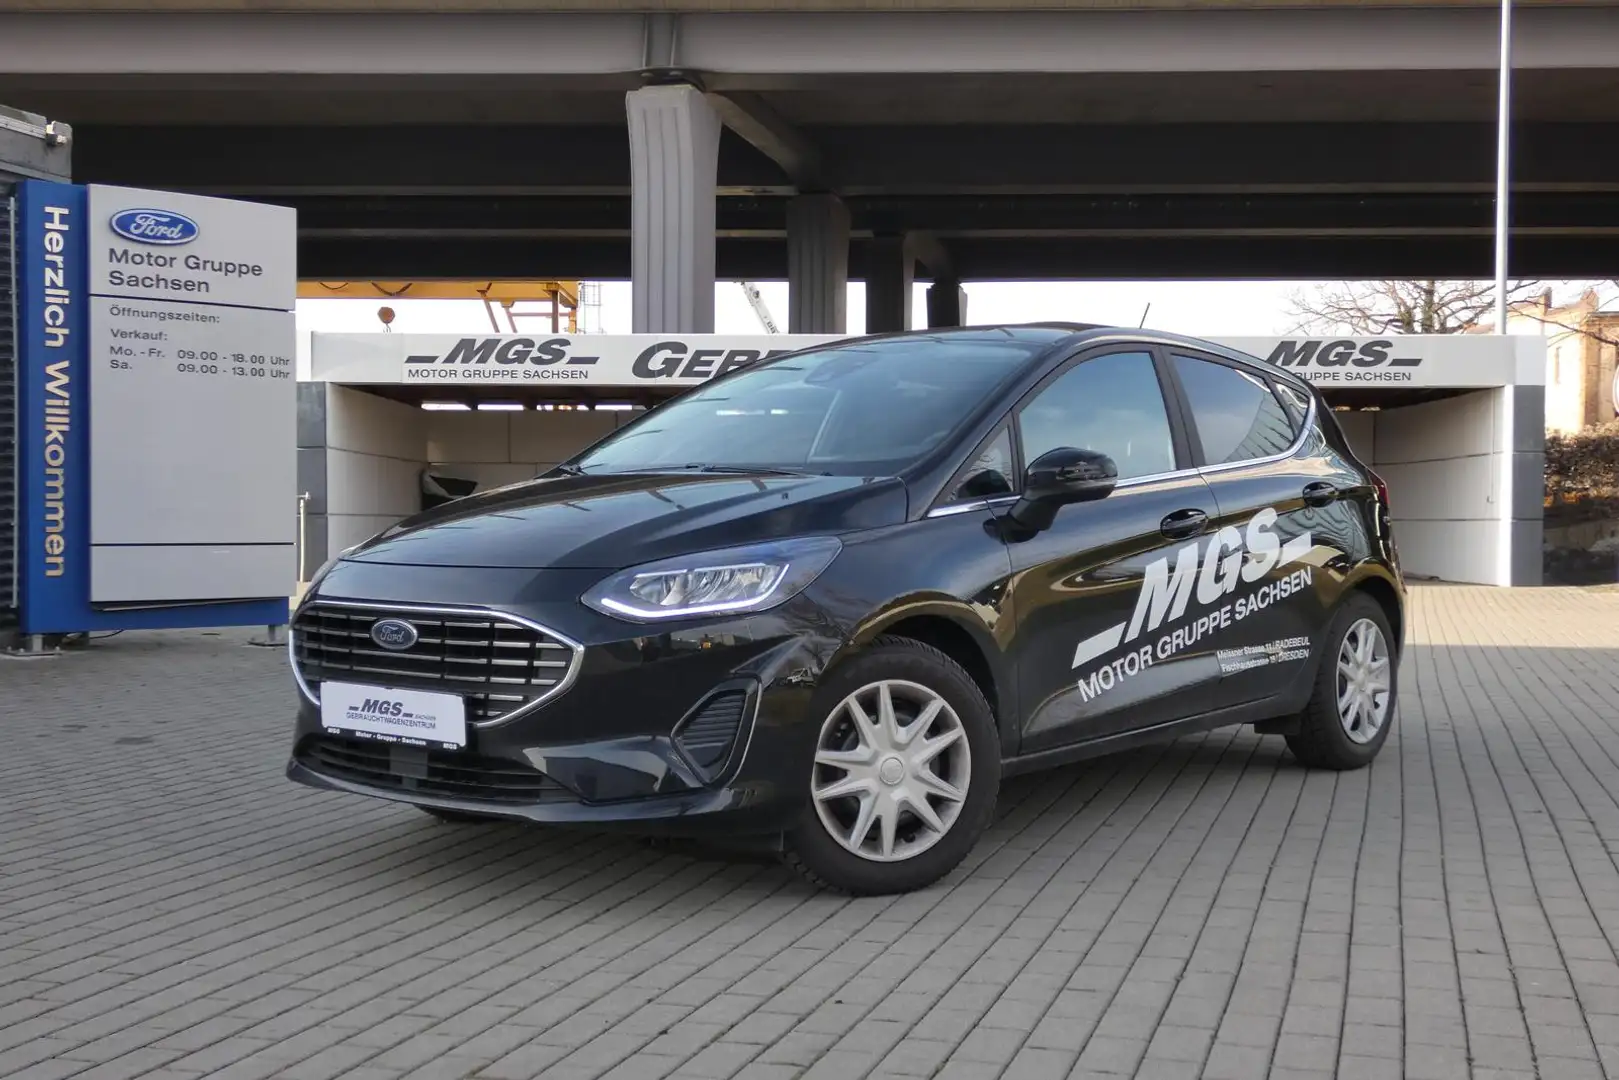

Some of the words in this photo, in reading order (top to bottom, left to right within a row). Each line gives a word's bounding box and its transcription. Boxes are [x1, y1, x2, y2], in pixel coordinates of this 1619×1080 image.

[130, 213, 184, 239] Ford
[108, 247, 177, 269] Motor
[184, 254, 264, 278] Gruppe
[44, 206, 70, 348] Herzlich
[108, 270, 210, 293] Sachsen
[109, 304, 220, 324] Öffnungszeiten:
[110, 328, 168, 341] Verkauf:
[110, 346, 136, 357] Mo.
[148, 348, 165, 358] Fr.
[177, 349, 218, 361] 09.00
[270, 356, 290, 366] Uhr
[441, 338, 572, 365] MGS
[1266, 340, 1394, 367] MGS
[110, 359, 132, 370] Sa.
[177, 363, 218, 375] 09.00
[231, 367, 265, 378] 13.00
[270, 369, 290, 379] Uhr
[408, 369, 458, 380] MOTOR
[462, 369, 519, 380] GRUPPE
[523, 369, 589, 380] SACHSEN
[1344, 371, 1412, 382] SACHSEN
[44, 360, 70, 578] Willkommen
[380, 624, 404, 642] Ford
[1077, 644, 1153, 703] MOTOR
[1156, 604, 1232, 660] GRUPPE
[1234, 565, 1313, 621] SACHSEN
[361, 698, 404, 718] MGS
[345, 711, 437, 730] GEBRAUCHTWAGENZENTRUM
